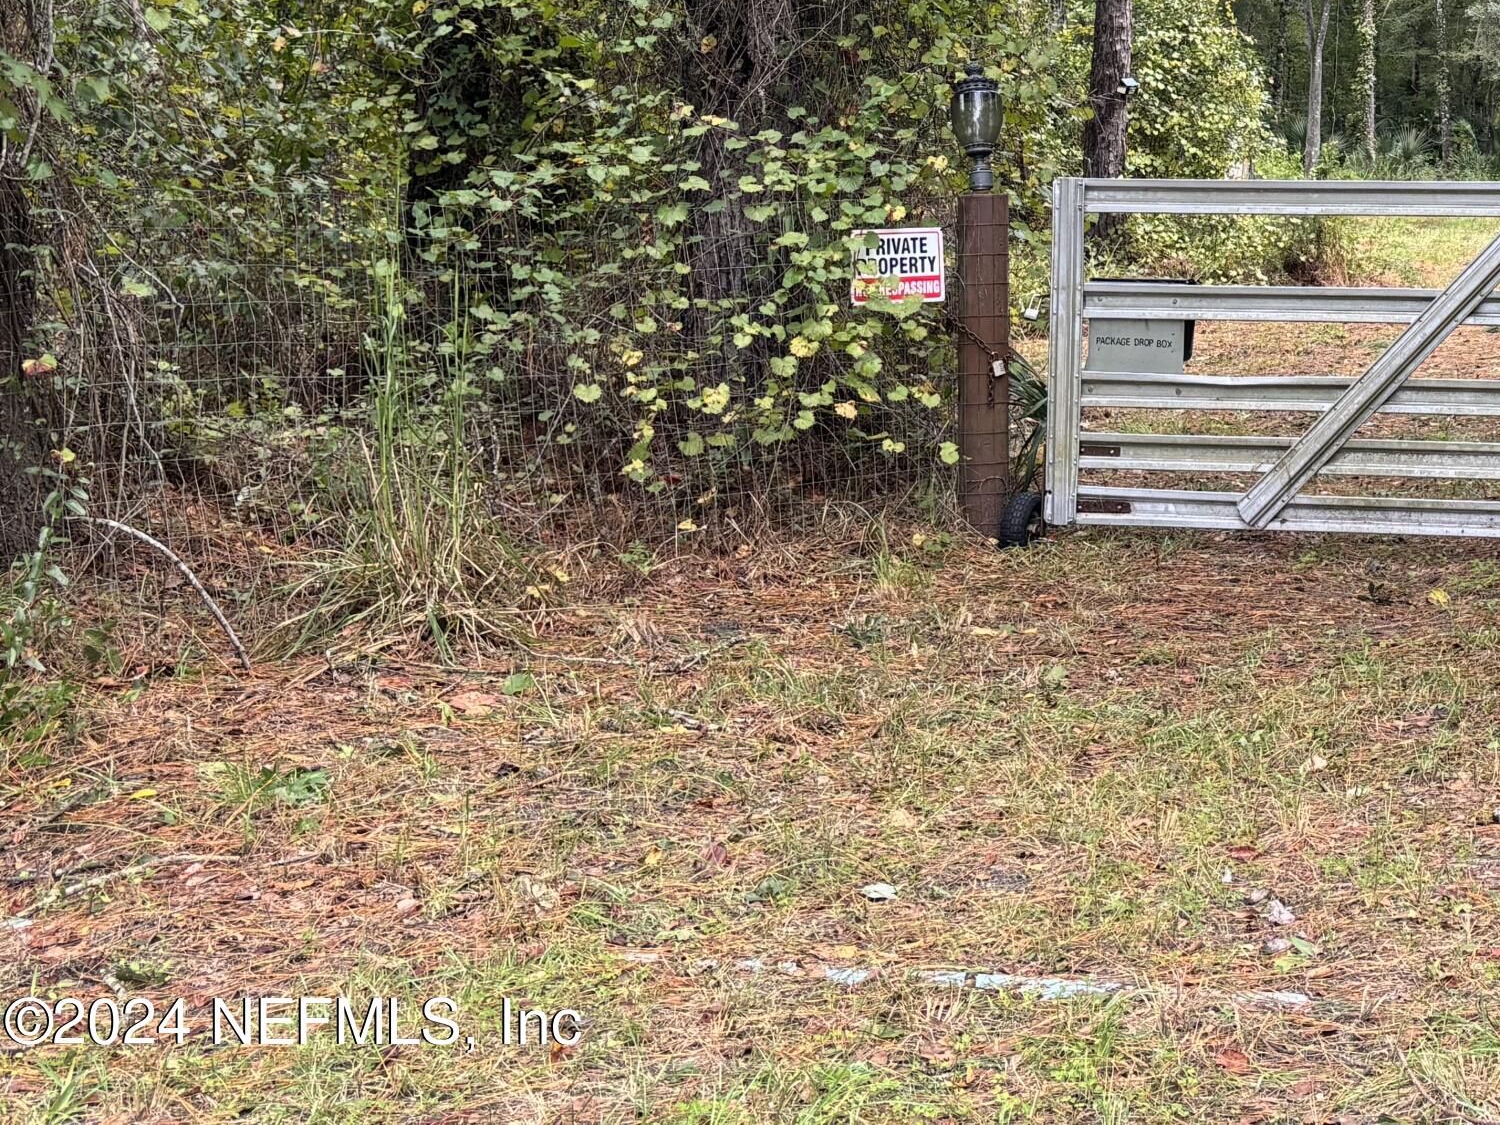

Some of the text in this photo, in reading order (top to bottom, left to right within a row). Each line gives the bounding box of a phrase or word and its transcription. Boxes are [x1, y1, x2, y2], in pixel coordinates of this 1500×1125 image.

[1096, 336, 1173, 349] PACKAGE DROP BOX
